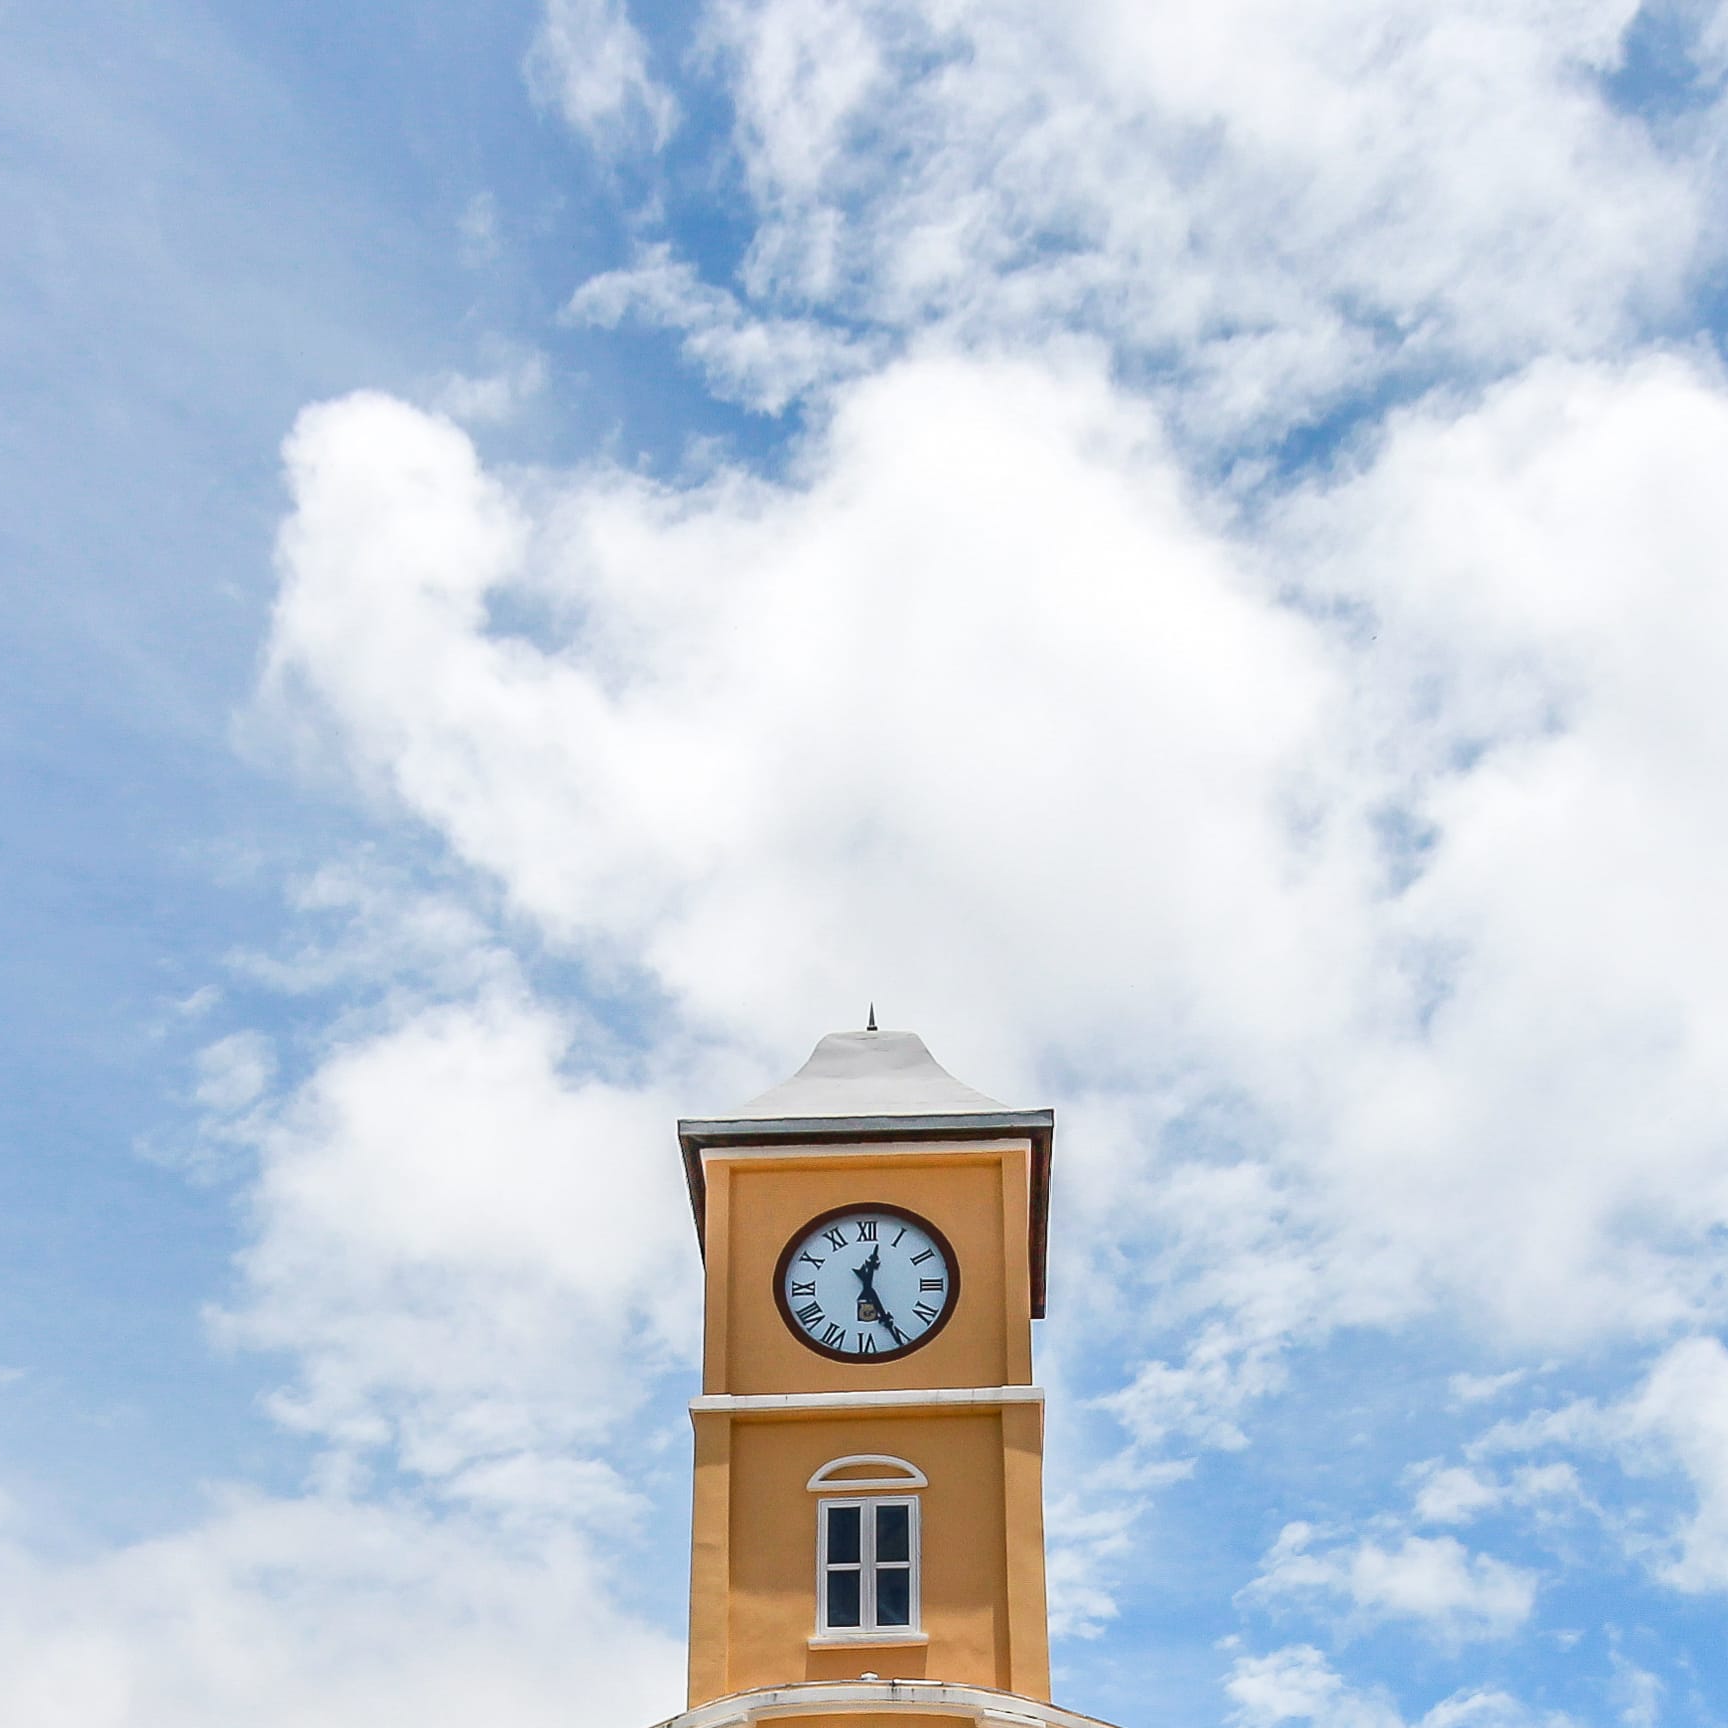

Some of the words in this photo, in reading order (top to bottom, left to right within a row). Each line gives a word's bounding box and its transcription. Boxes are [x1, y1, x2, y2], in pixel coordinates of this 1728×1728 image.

[822, 1226, 849, 1252] XI
[856, 1221, 878, 1242] XII
[890, 1227, 907, 1248] I
[799, 1251, 826, 1270] X
[910, 1248, 935, 1266] II
[792, 1280, 816, 1297] IX
[919, 1278, 944, 1292] III
[795, 1300, 826, 1331] VIII
[912, 1301, 939, 1327] IV
[821, 1322, 847, 1350] VII
[857, 1332, 877, 1353] VI
